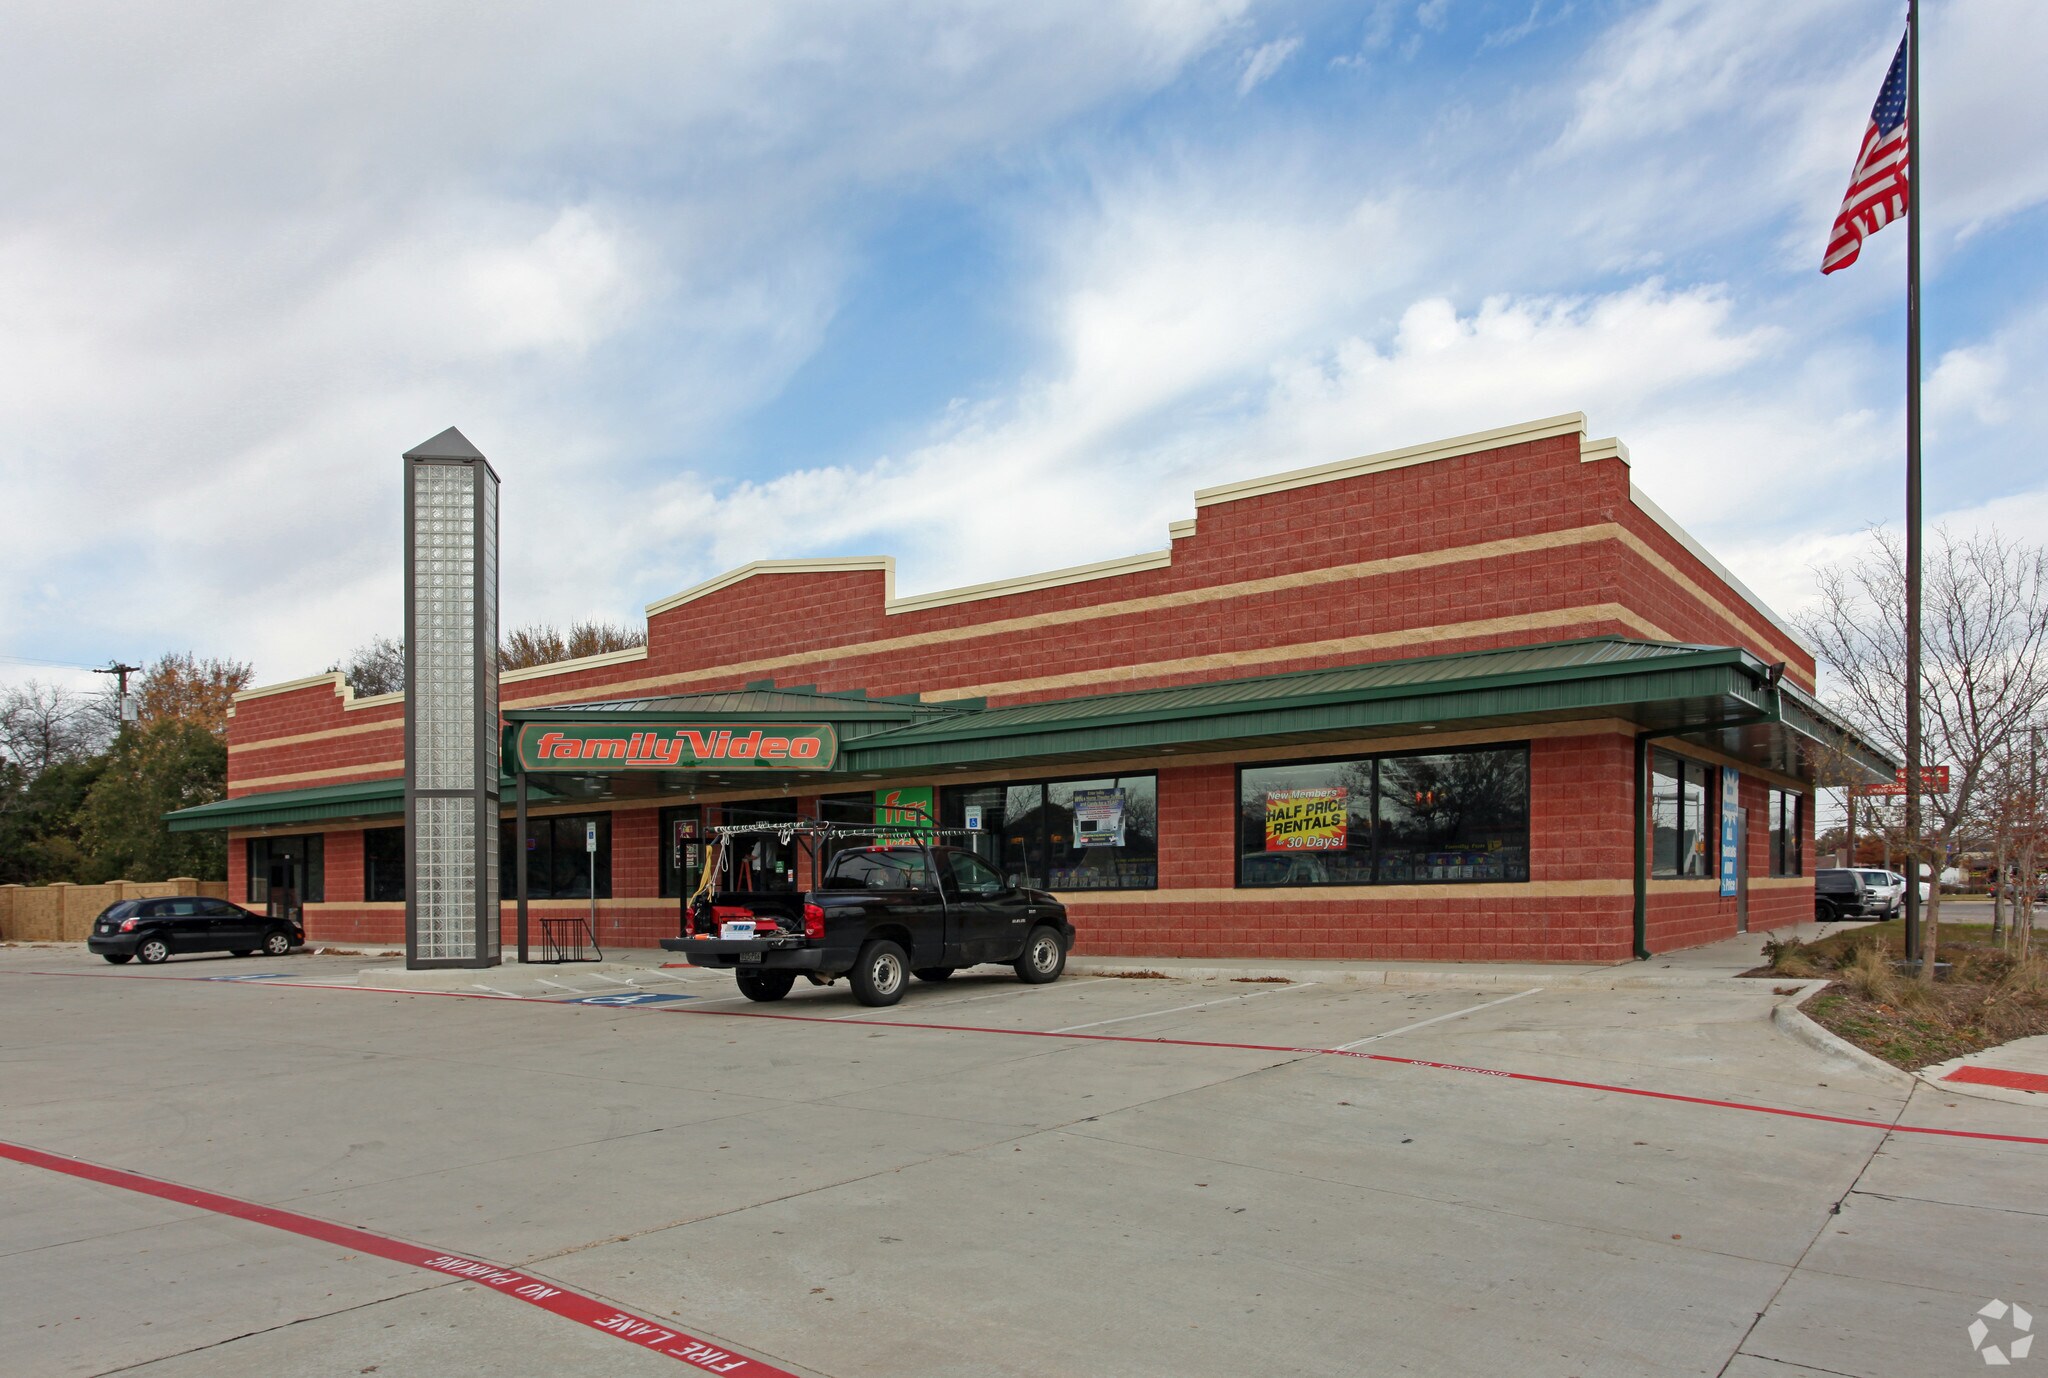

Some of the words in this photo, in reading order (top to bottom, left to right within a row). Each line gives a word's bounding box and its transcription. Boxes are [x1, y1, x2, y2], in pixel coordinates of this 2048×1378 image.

[1267, 791, 1289, 800] New
[1291, 789, 1338, 799] Members
[1266, 804, 1303, 822] HALF
[1305, 797, 1346, 817] PRICE
[1273, 813, 1341, 835] RENTALS
[1286, 836, 1303, 848] 30
[1306, 834, 1345, 849] Days!
[424, 1256, 522, 1285] PARKING
[515, 1283, 562, 1300] NO
[593, 1313, 677, 1344] LANE
[668, 1341, 748, 1372] FIRE
